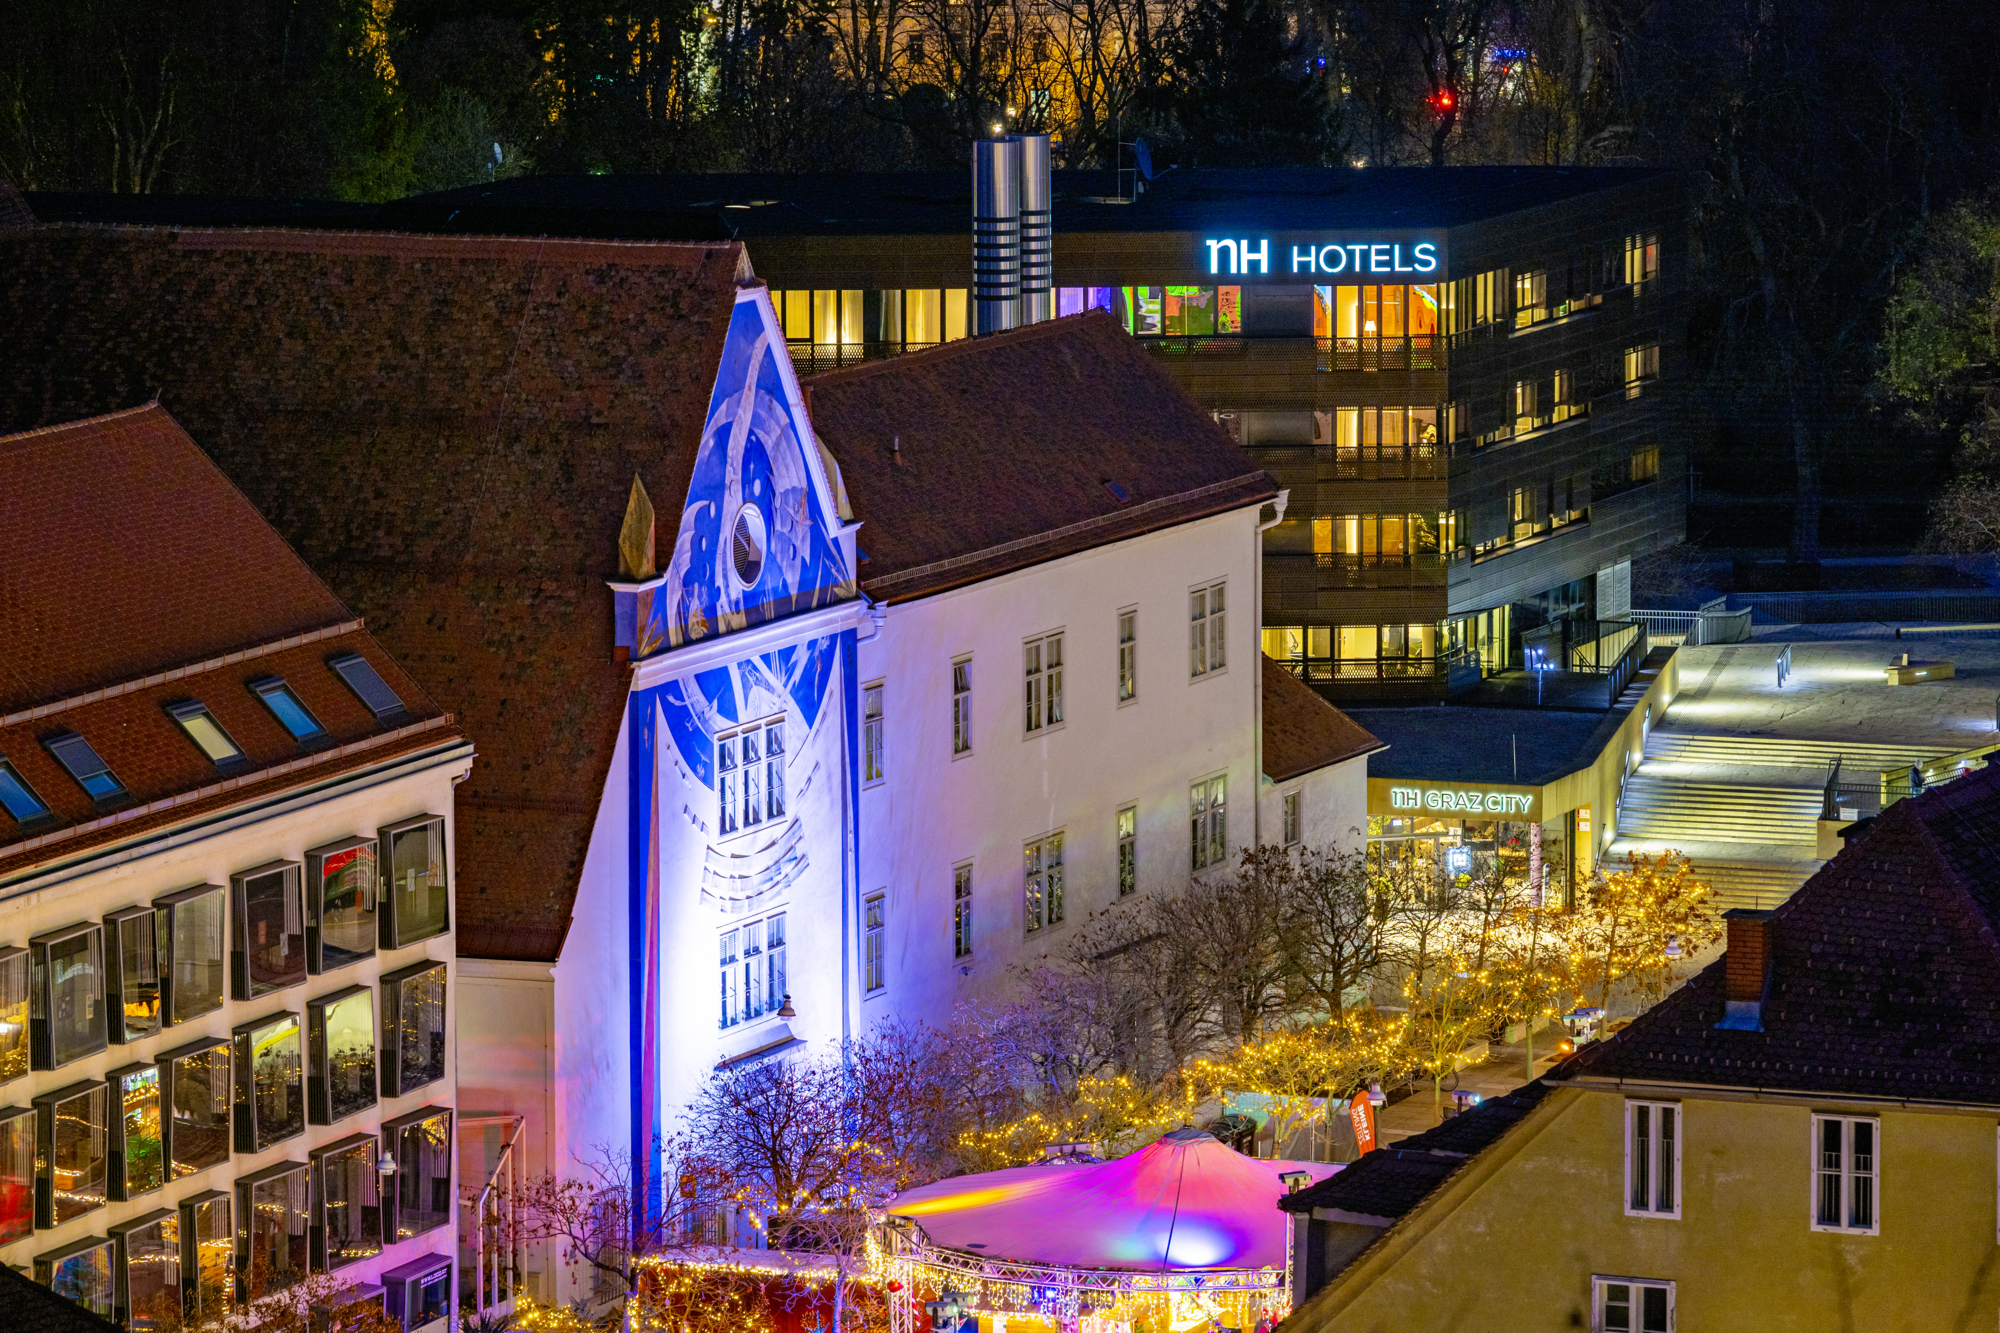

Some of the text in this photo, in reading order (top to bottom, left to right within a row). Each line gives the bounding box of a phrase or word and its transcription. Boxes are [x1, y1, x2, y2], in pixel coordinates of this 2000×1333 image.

[1292, 243, 1437, 273] HOTELS
[1425, 791, 1482, 810] GRAZ
[1485, 795, 1531, 813] CITY
